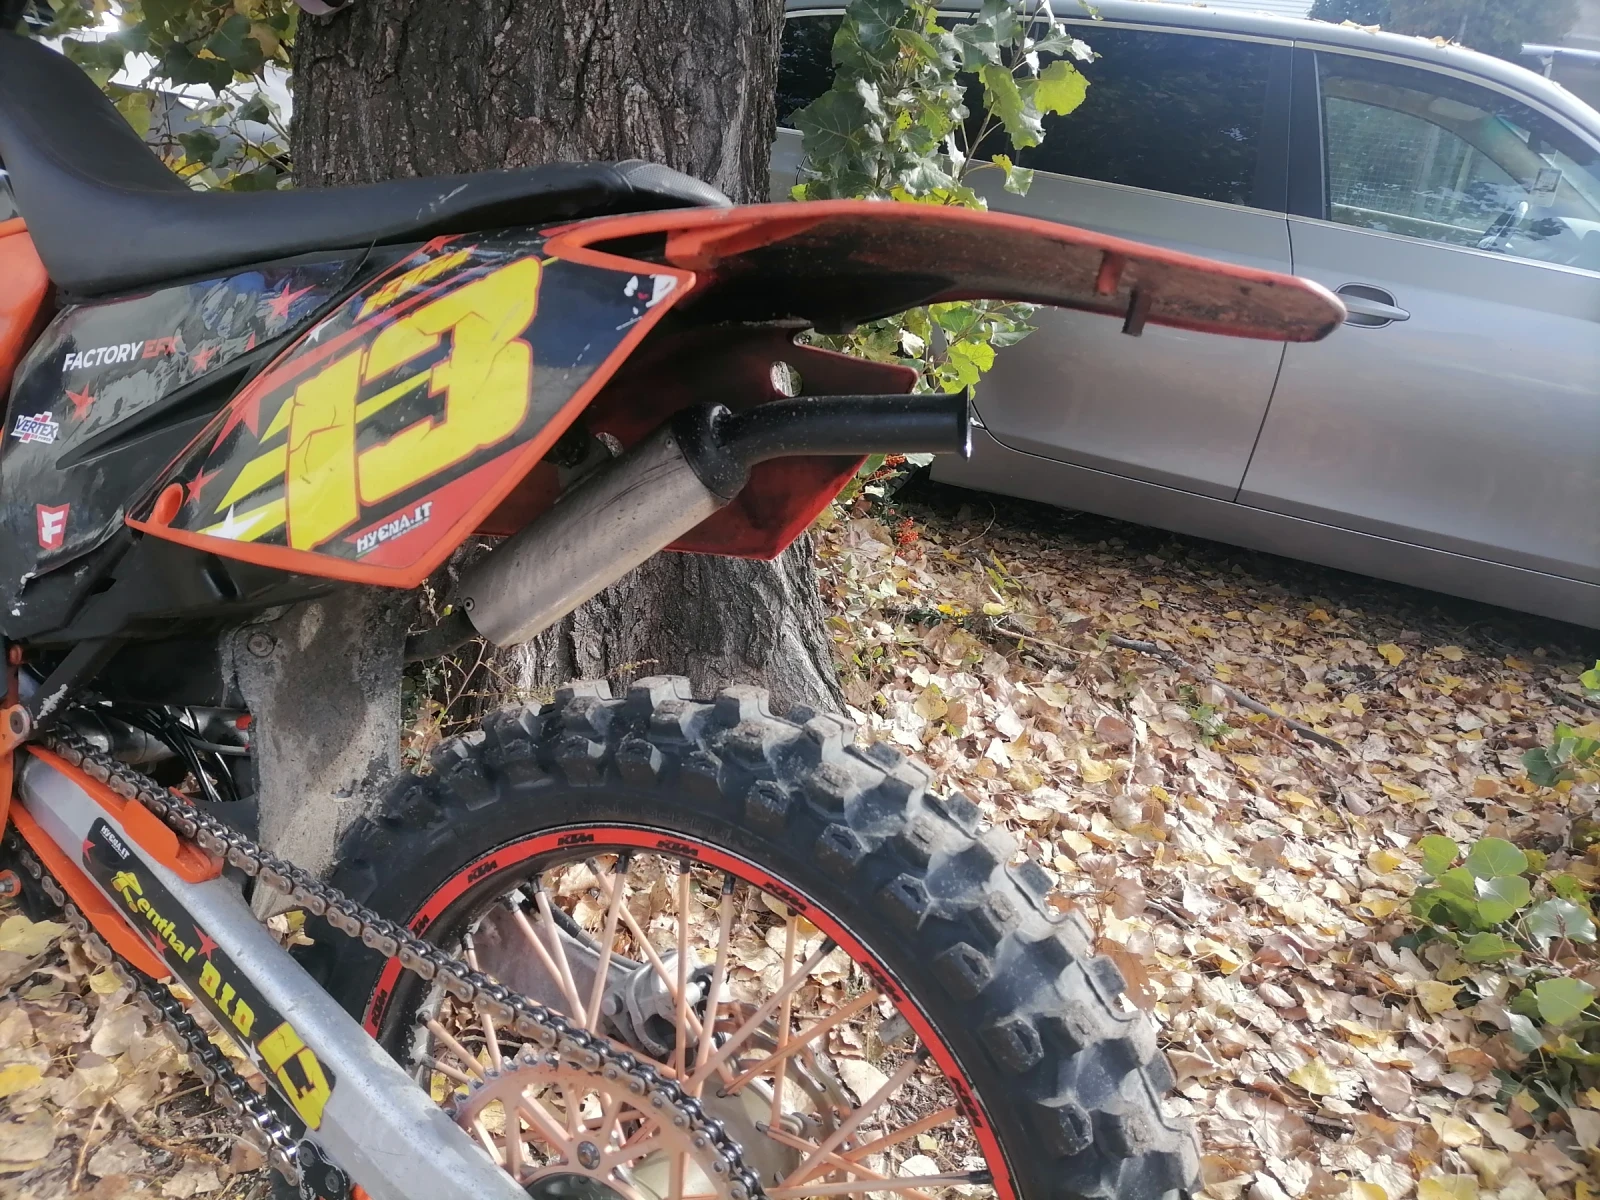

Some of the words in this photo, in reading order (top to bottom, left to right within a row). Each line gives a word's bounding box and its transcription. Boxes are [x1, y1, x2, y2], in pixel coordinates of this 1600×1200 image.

[287, 255, 542, 552] 13
[16, 418, 58, 437] VERTEX
[41, 510, 64, 544] F
[356, 501, 433, 553] HYENA.IT
[556, 833, 595, 847] KTM
[656, 839, 699, 856] KTM
[467, 859, 498, 884] KTM
[763, 881, 807, 911] KTM
[110, 870, 196, 963] Renthal
[411, 914, 430, 938] TM
[861, 961, 903, 1002] KTM
[371, 988, 388, 1028] KTM
[950, 1076, 983, 1128] KTM
